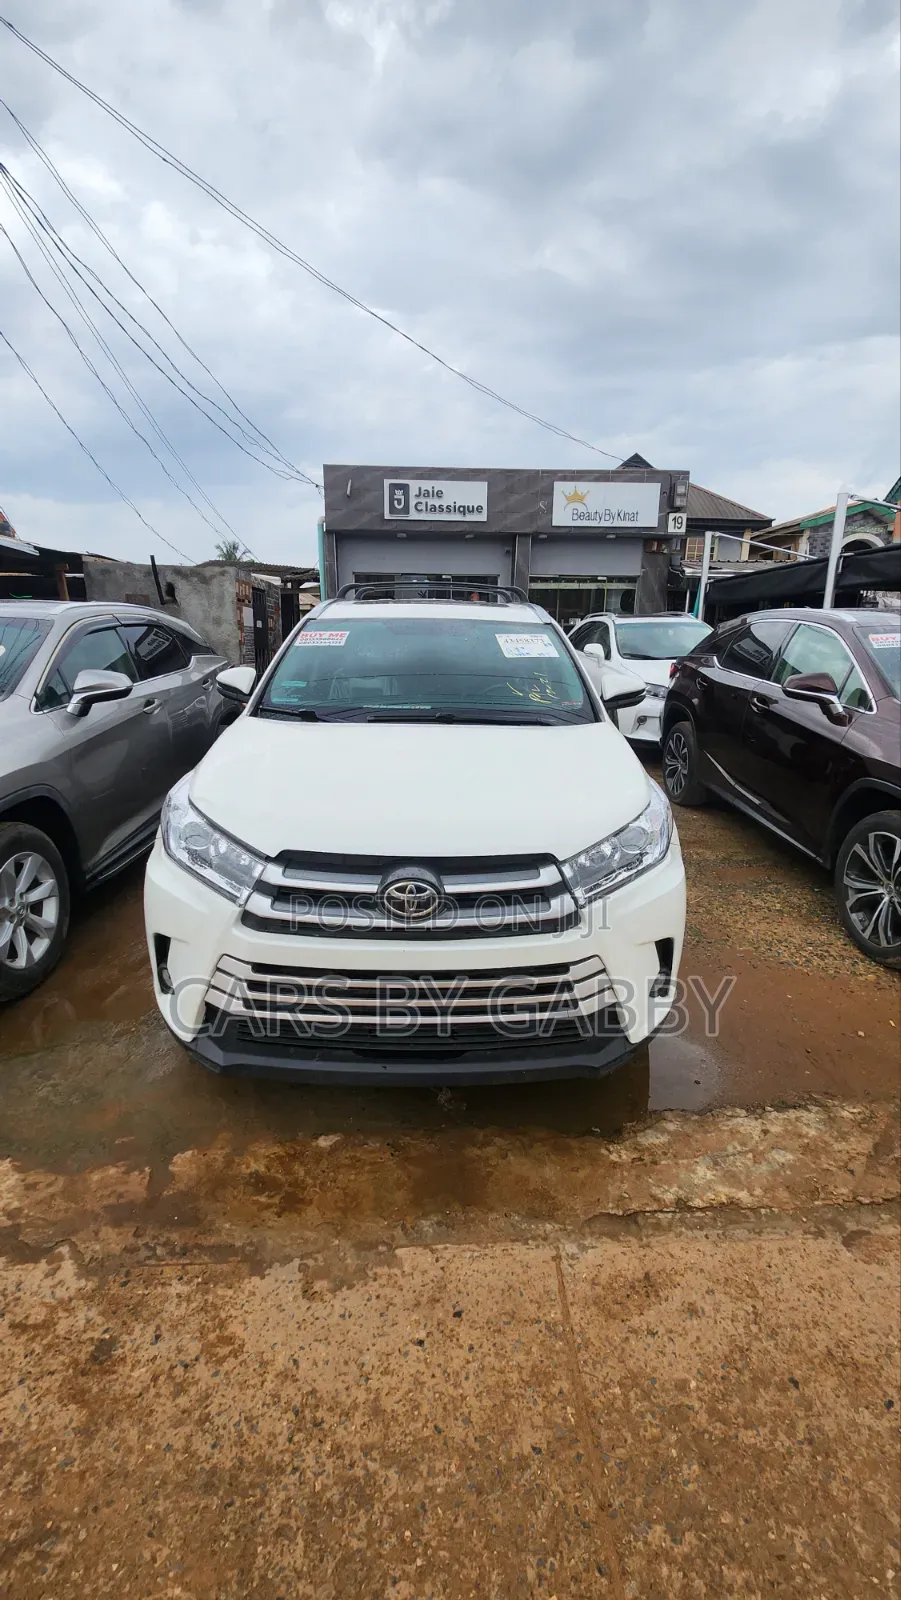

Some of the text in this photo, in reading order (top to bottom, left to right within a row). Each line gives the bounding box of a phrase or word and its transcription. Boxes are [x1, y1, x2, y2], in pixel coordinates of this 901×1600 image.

[414, 486, 444, 498] Jaie
[414, 501, 484, 516] Classique
[572, 508, 603, 524] Beauty
[604, 509, 616, 524] By
[671, 515, 683, 530] 19
